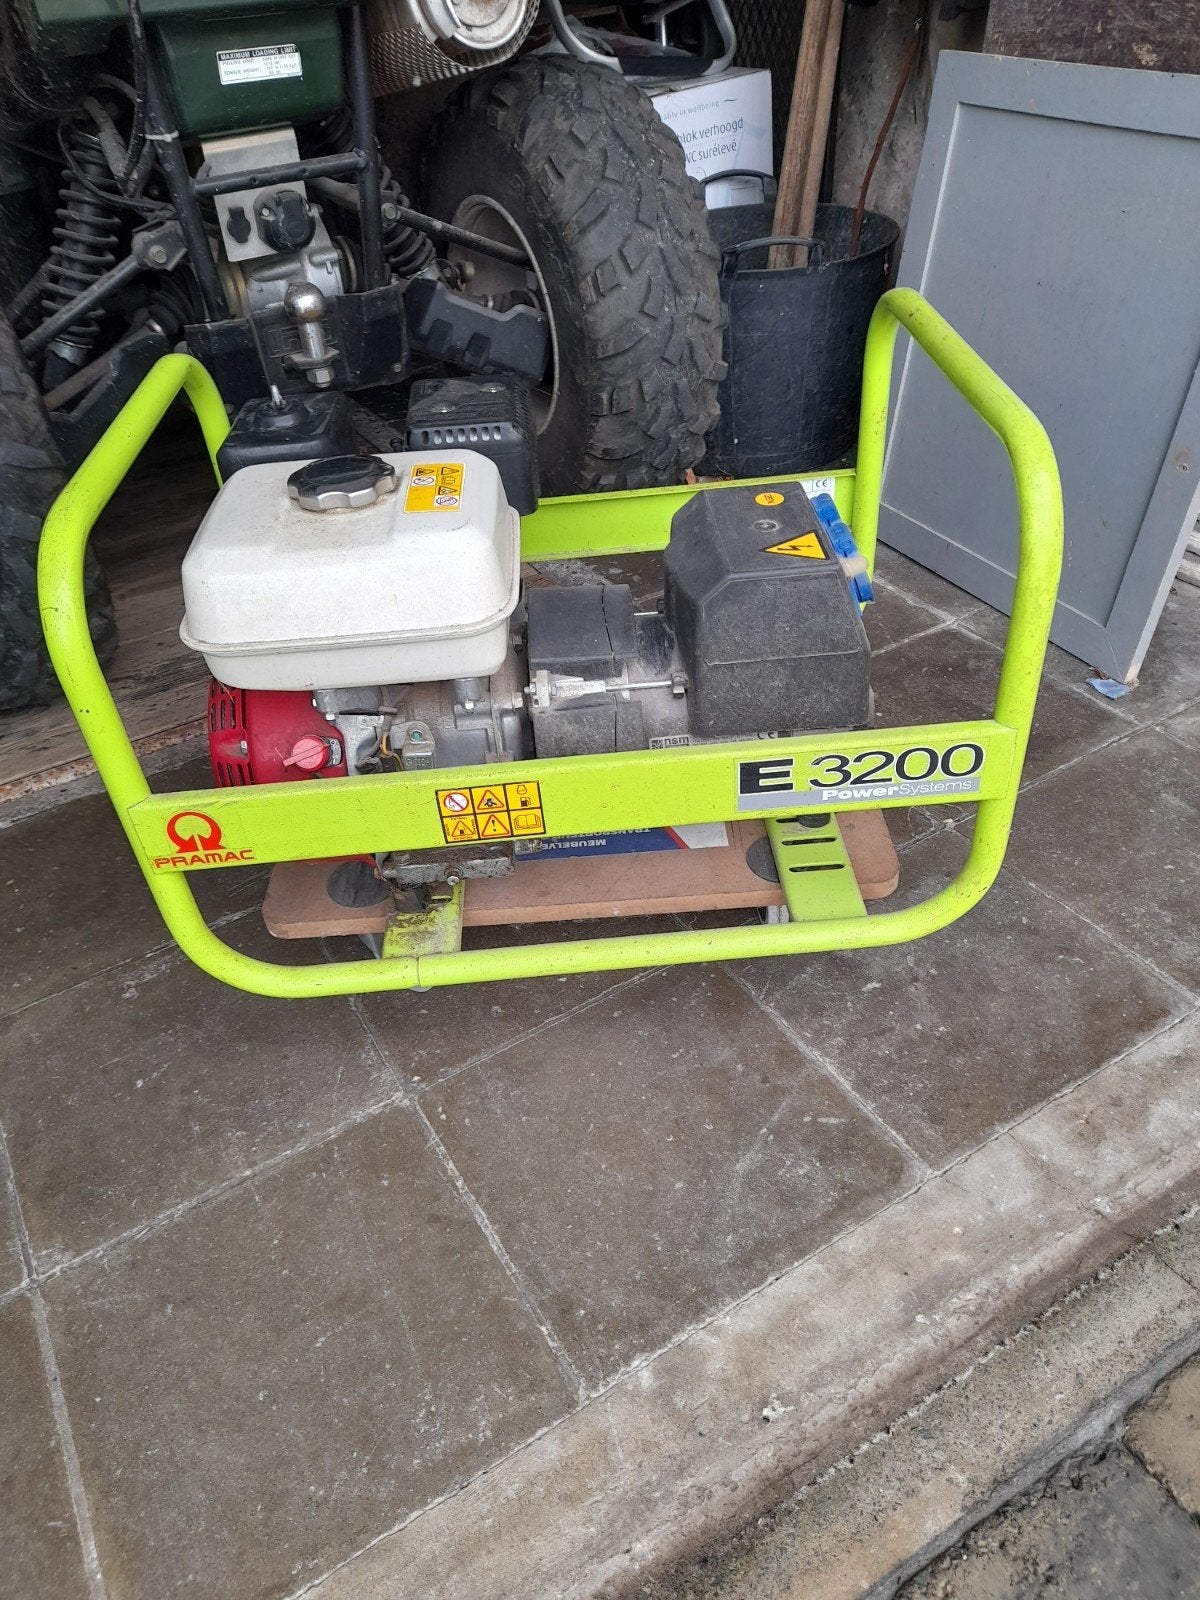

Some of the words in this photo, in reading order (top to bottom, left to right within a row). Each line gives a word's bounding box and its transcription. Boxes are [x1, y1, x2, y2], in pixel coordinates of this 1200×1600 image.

[220, 51, 250, 59] MAXIMUM
[252, 48, 279, 57] LOADING
[280, 46, 296, 54] LIMIT
[698, 116, 744, 139] verhoogd
[698, 138, 737, 161] surélevé
[815, 479, 828, 488] CE
[664, 736, 689, 746] nsm
[740, 758, 794, 795] E
[809, 743, 985, 788] 3200
[822, 779, 972, 801] PowerSystems
[153, 849, 256, 869] PRAMAC
